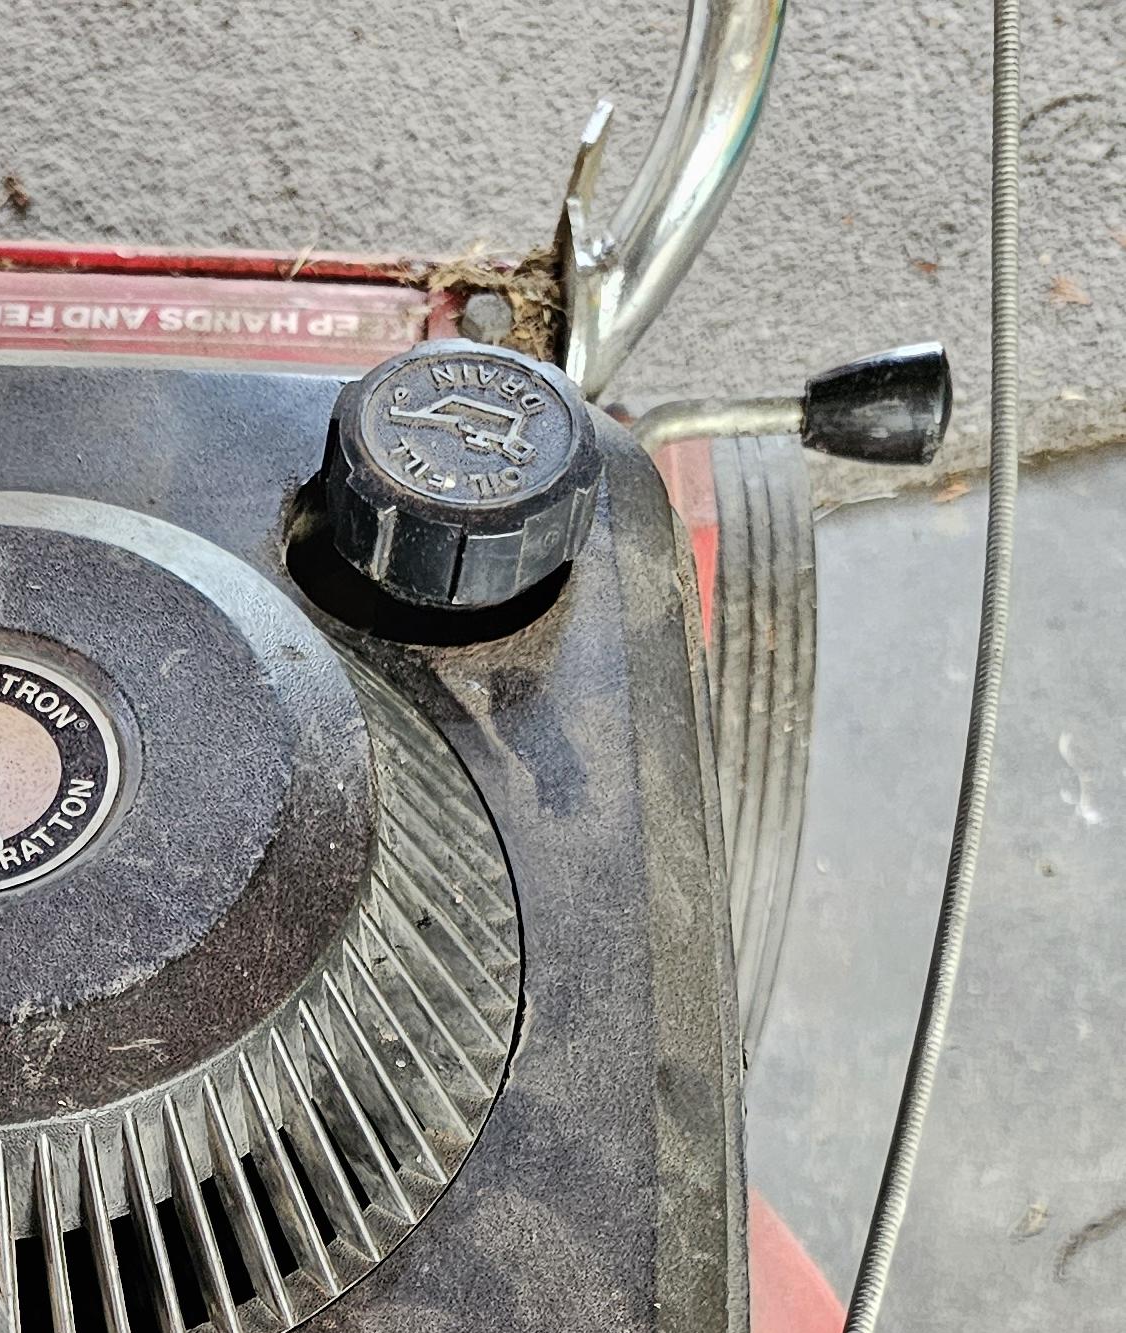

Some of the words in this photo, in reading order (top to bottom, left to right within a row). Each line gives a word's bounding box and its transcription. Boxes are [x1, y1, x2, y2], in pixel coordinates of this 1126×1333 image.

[61, 305, 151, 331] AND
[156, 307, 298, 335] HANDS
[431, 364, 546, 415] DRAIN
[466, 466, 525, 496] OIL
